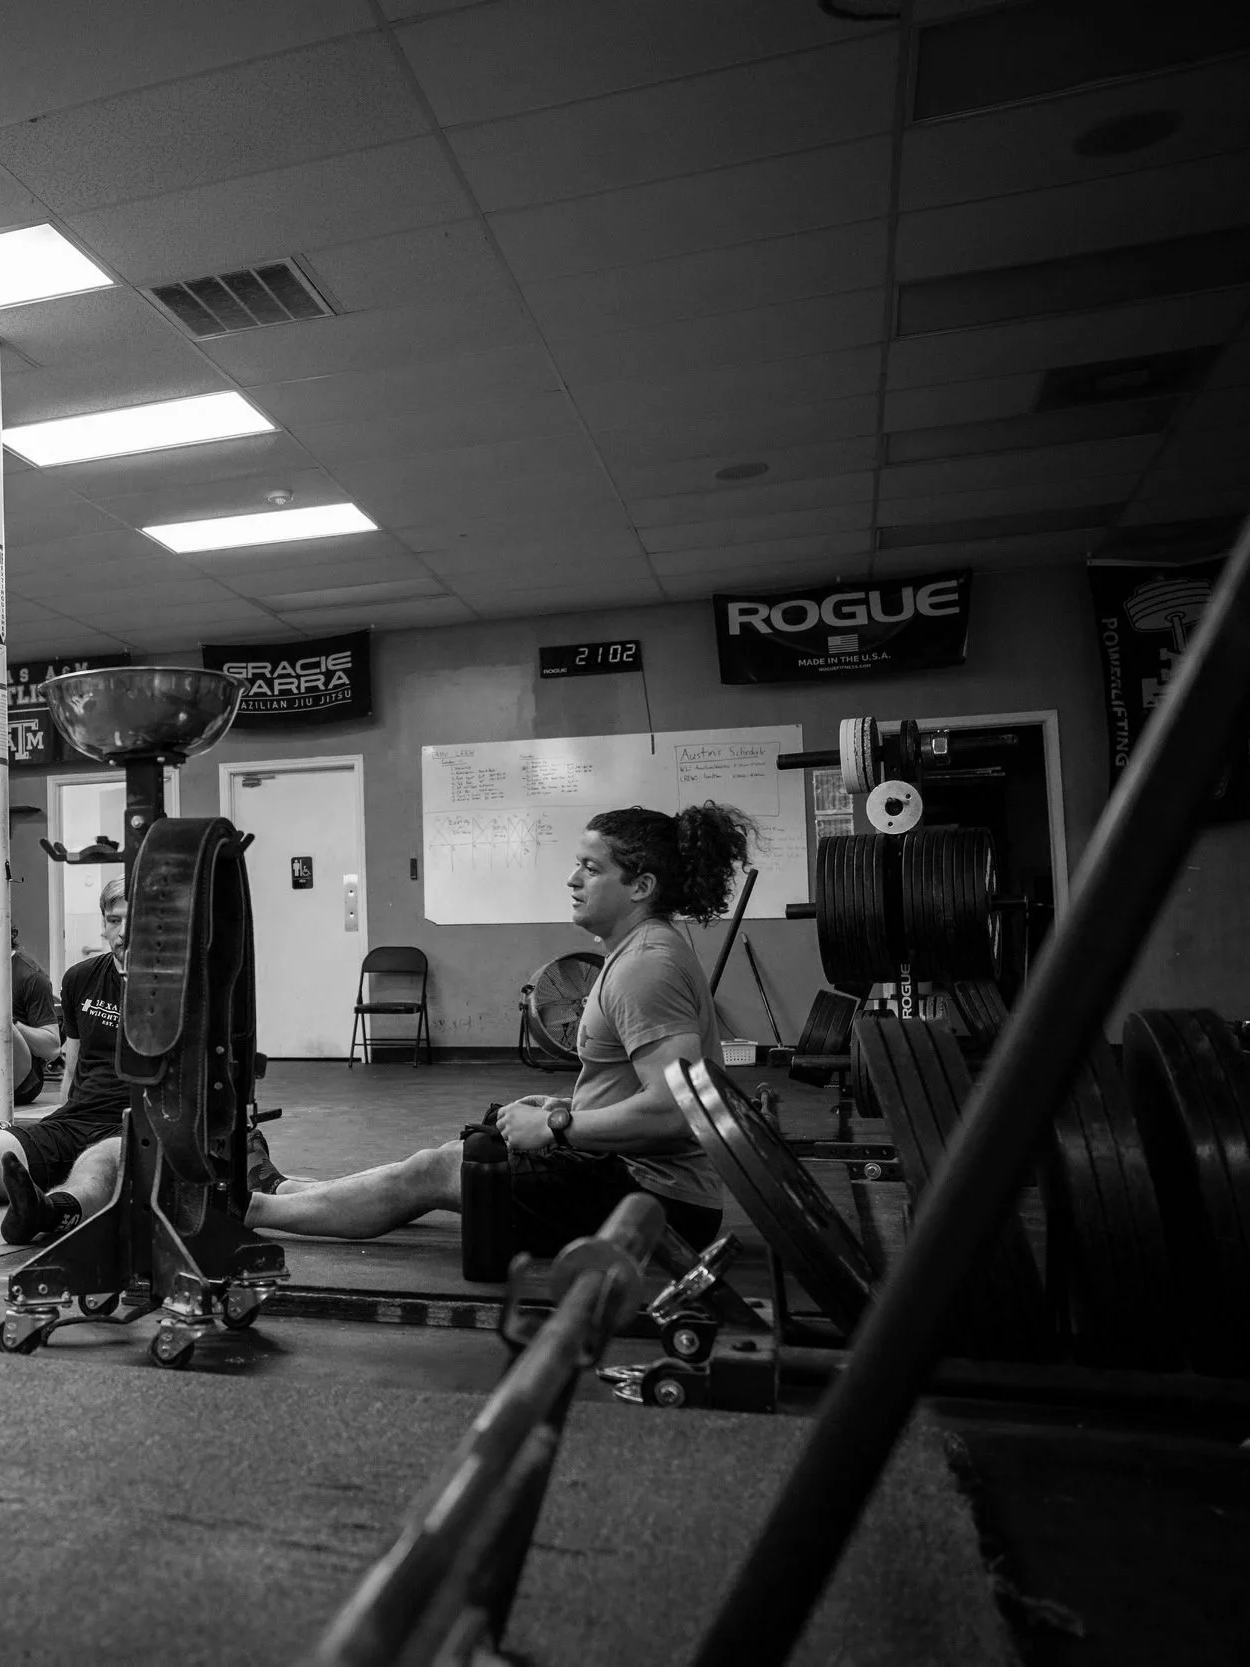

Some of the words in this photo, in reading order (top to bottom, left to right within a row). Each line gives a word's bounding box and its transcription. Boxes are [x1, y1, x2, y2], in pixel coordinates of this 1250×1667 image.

[727, 580, 961, 636] ROGUE
[223, 651, 352, 679] GRACIE
[798, 658, 825, 667] MADE
[840, 655, 859, 663] THE
[861, 652, 891, 661] U.S.A.
[249, 671, 350, 696] ARRA
[240, 700, 287, 710] AZILIAN
[293, 698, 313, 708] JIU
[319, 689, 352, 705] JITSU
[900, 962, 911, 1020] ROGUE
